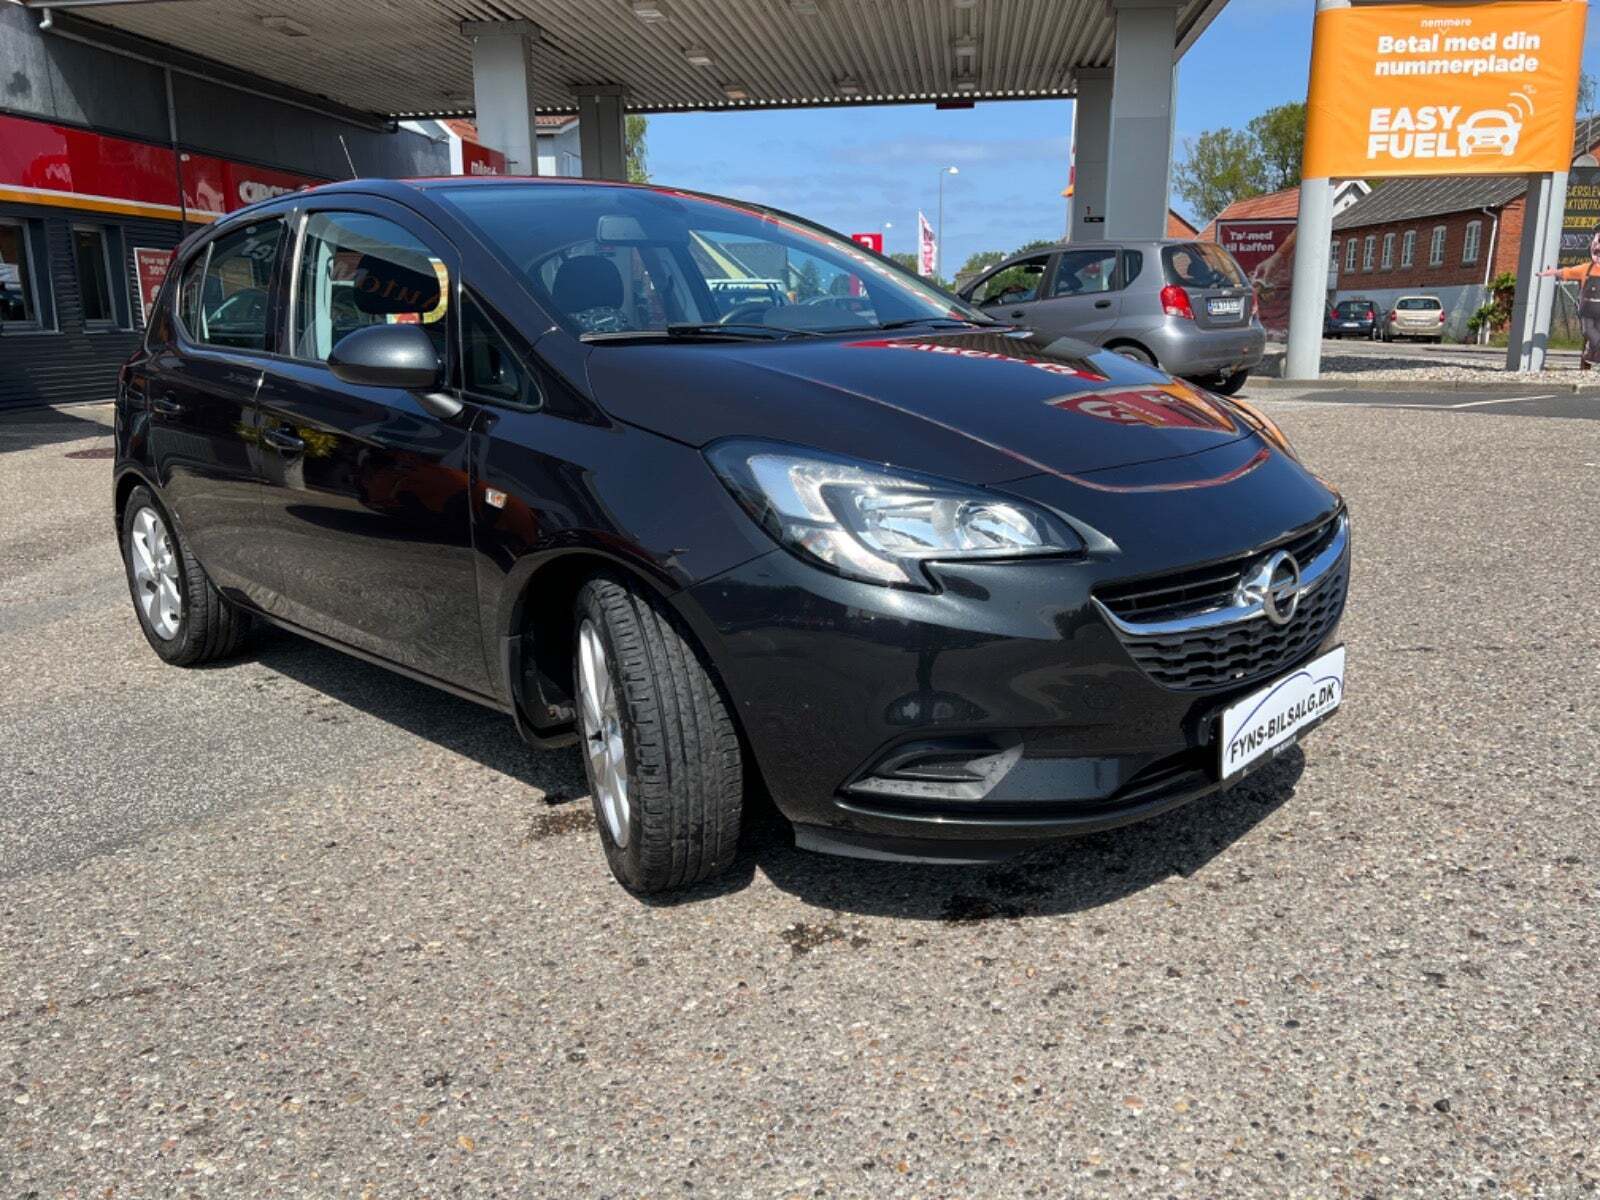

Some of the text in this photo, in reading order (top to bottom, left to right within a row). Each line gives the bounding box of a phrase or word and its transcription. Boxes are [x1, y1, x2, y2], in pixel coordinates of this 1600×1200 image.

[1421, 18, 1472, 27] nemmere
[1377, 32, 1541, 53] Betal med din
[1375, 54, 1539, 76] nummerplade
[1369, 105, 1461, 132] EASY
[1366, 132, 1457, 159] FUEL
[1239, 243, 1275, 252] kaffen
[1230, 682, 1335, 764] FYNS-BILSALG.DK
